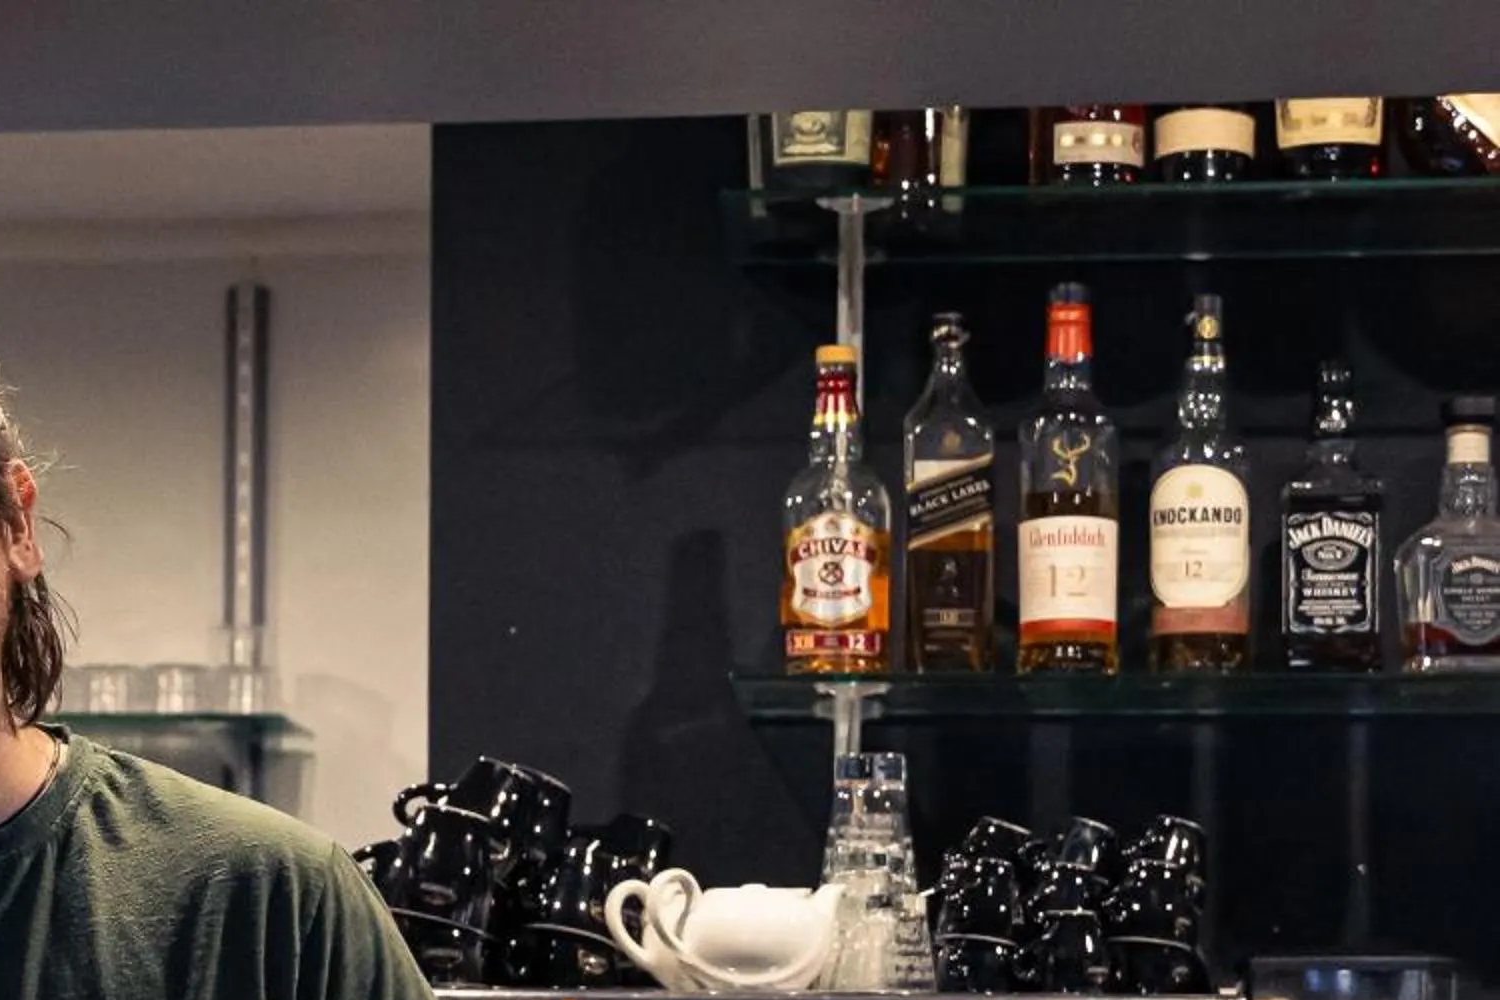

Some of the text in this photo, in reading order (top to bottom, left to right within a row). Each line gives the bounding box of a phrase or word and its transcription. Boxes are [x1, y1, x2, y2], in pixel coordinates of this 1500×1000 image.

[1153, 506, 1243, 526] KNOCKANDO
[1287, 520, 1321, 549] JACK
[798, 537, 868, 559] CHIVAS
[1184, 560, 1203, 578] 12
[1048, 564, 1088, 598] 12
